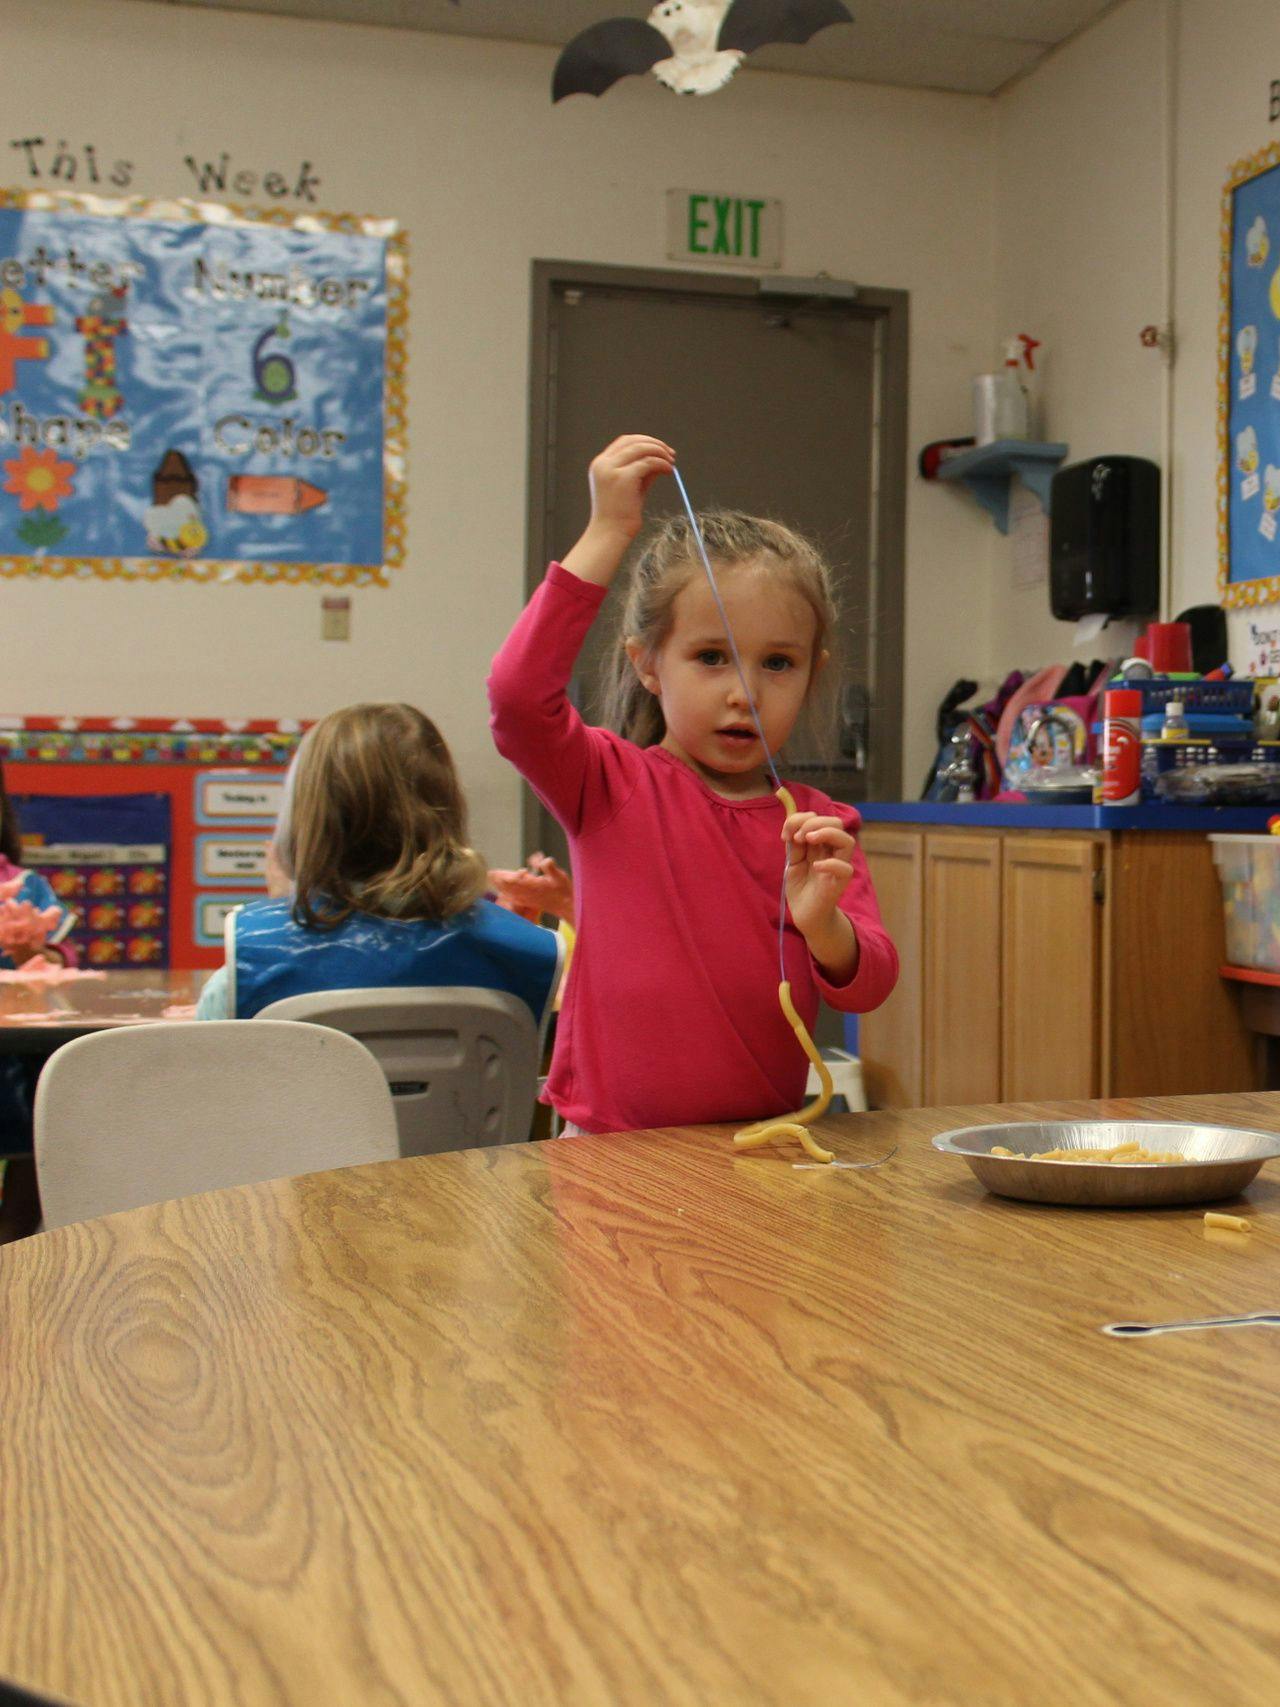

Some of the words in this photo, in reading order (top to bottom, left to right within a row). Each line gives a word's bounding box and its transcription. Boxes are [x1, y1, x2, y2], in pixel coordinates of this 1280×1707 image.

[9, 136, 132, 188] This
[184, 152, 320, 202] Week
[688, 194, 765, 258] EXIT
[195, 256, 371, 308] Number
[213, 413, 347, 457] Color
